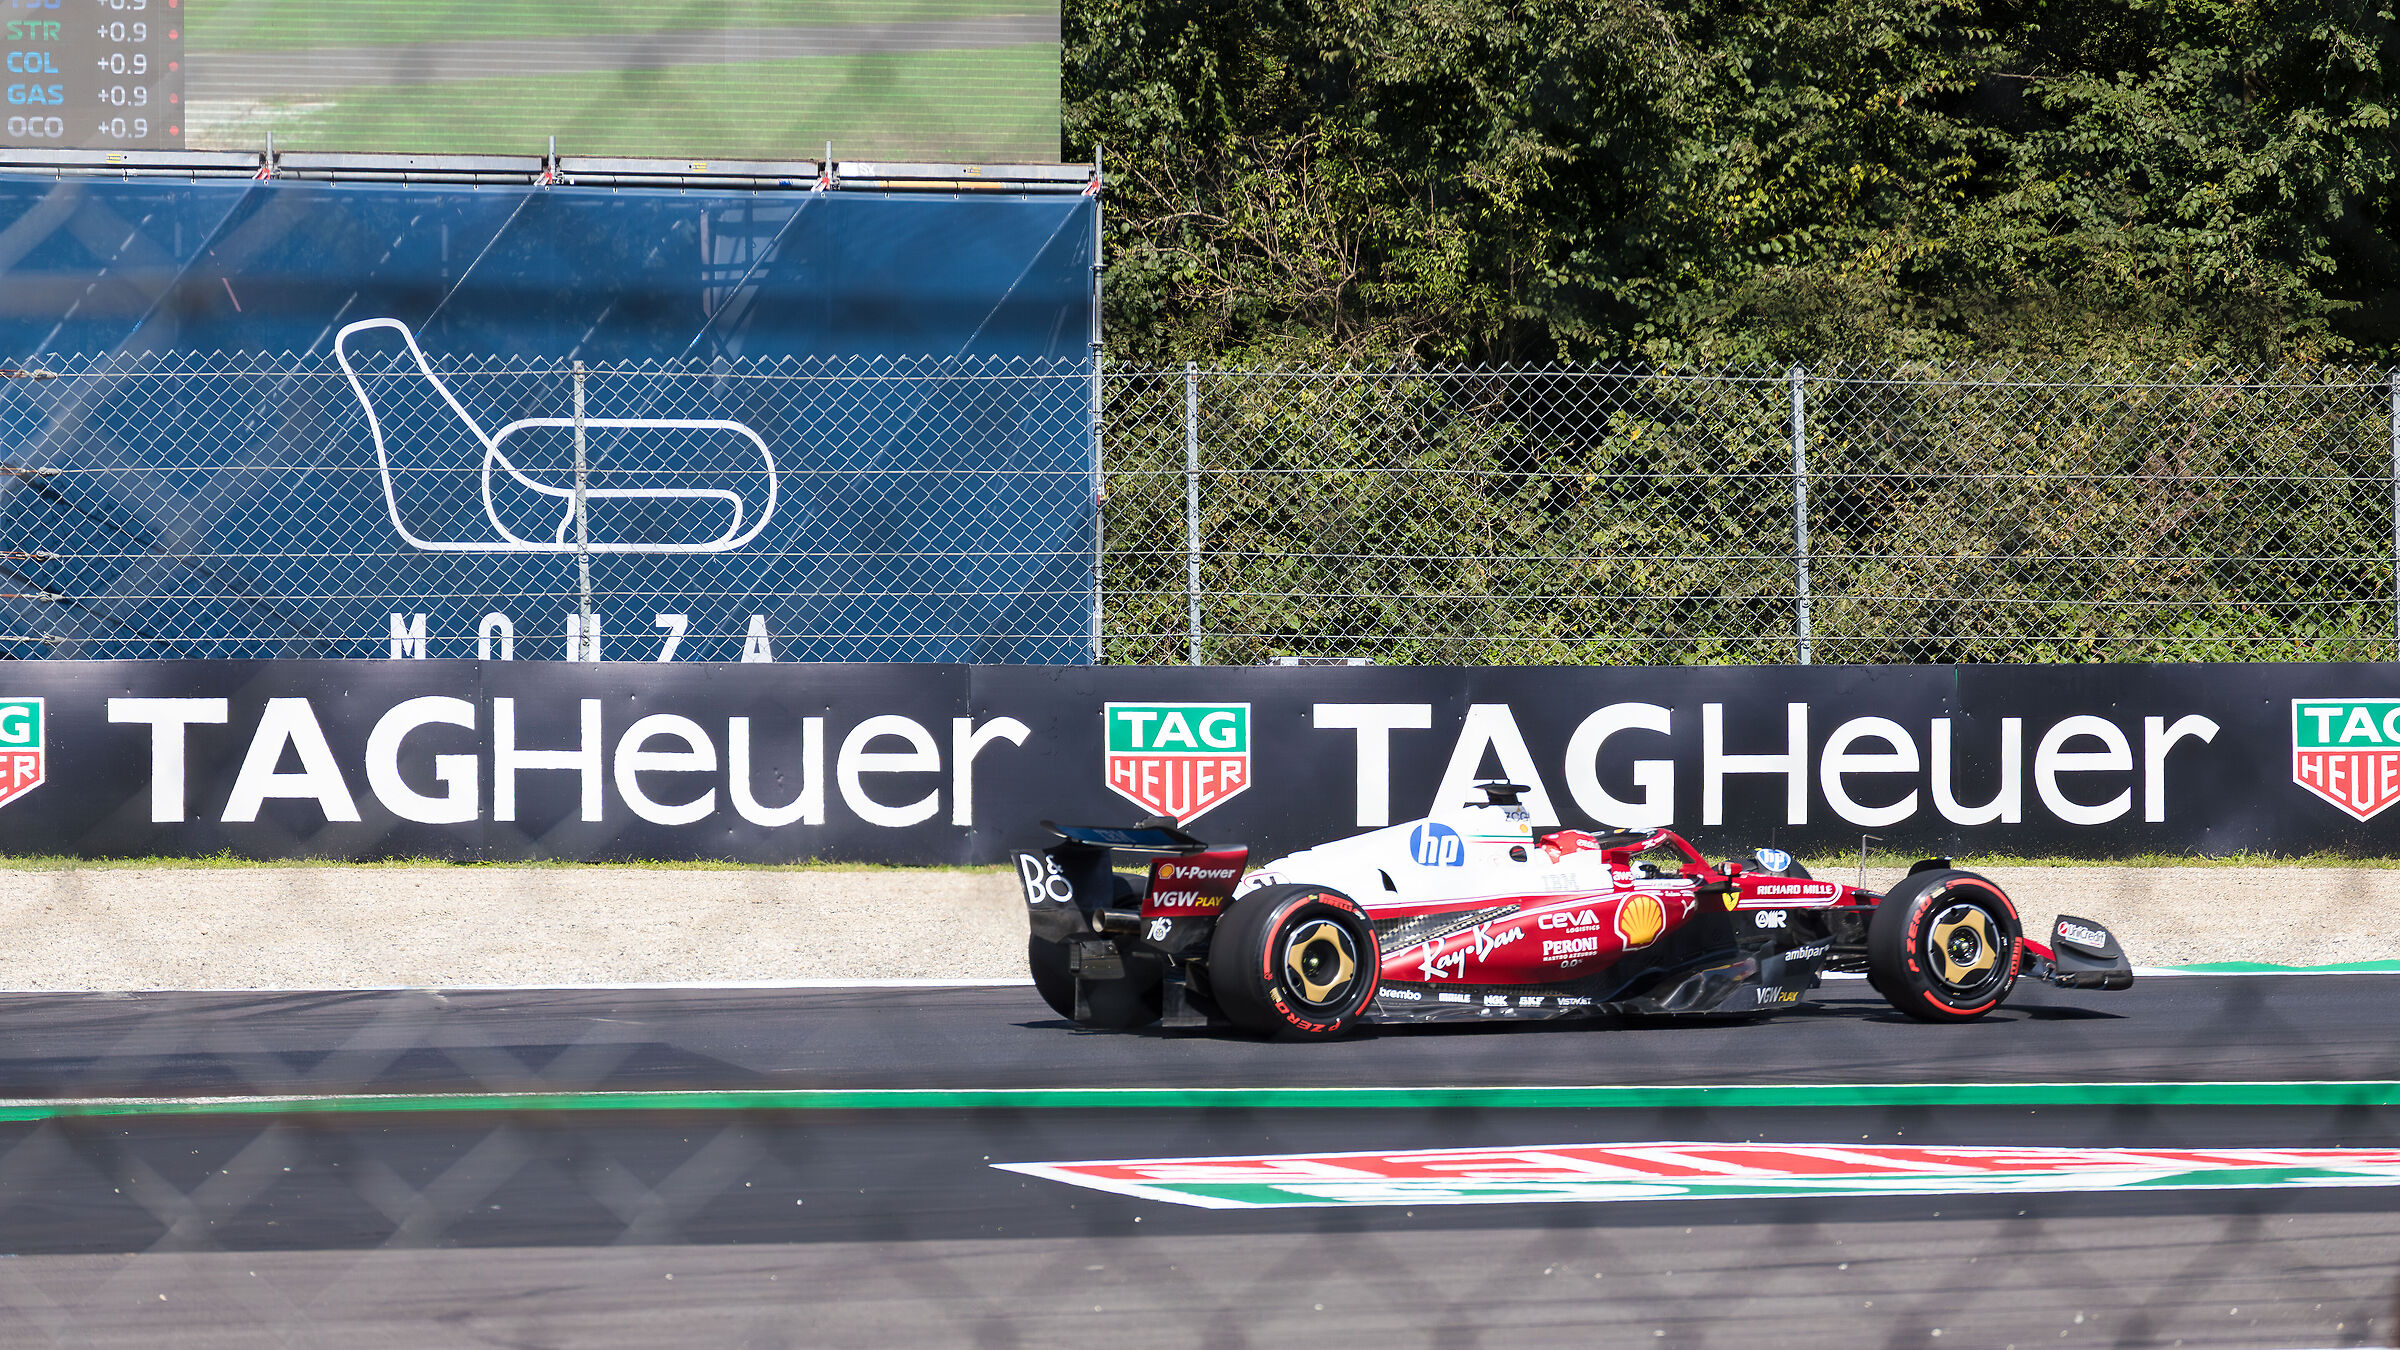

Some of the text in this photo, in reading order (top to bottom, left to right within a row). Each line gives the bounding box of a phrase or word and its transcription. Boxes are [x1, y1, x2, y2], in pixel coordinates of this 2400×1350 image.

[7, 20, 147, 42] STR +0.9
[7, 52, 147, 74] COL +0.9
[7, 84, 147, 106] GAS +0.9
[7, 116, 148, 138] OCO +0.9
[1117, 711, 1237, 749] TAG
[1114, 758, 1242, 817] HEUER
[2302, 755, 2398, 811] HEUE
[1418, 822, 1459, 866] hp
[1763, 850, 1785, 871] hp
[1175, 866, 1236, 880] V-Power
[1757, 884, 1833, 895] RICHARD MILLE
[1543, 936, 1598, 956] PERONI
[1379, 986, 1422, 1001] brembo
[1274, 1001, 1326, 1032] ZERO
